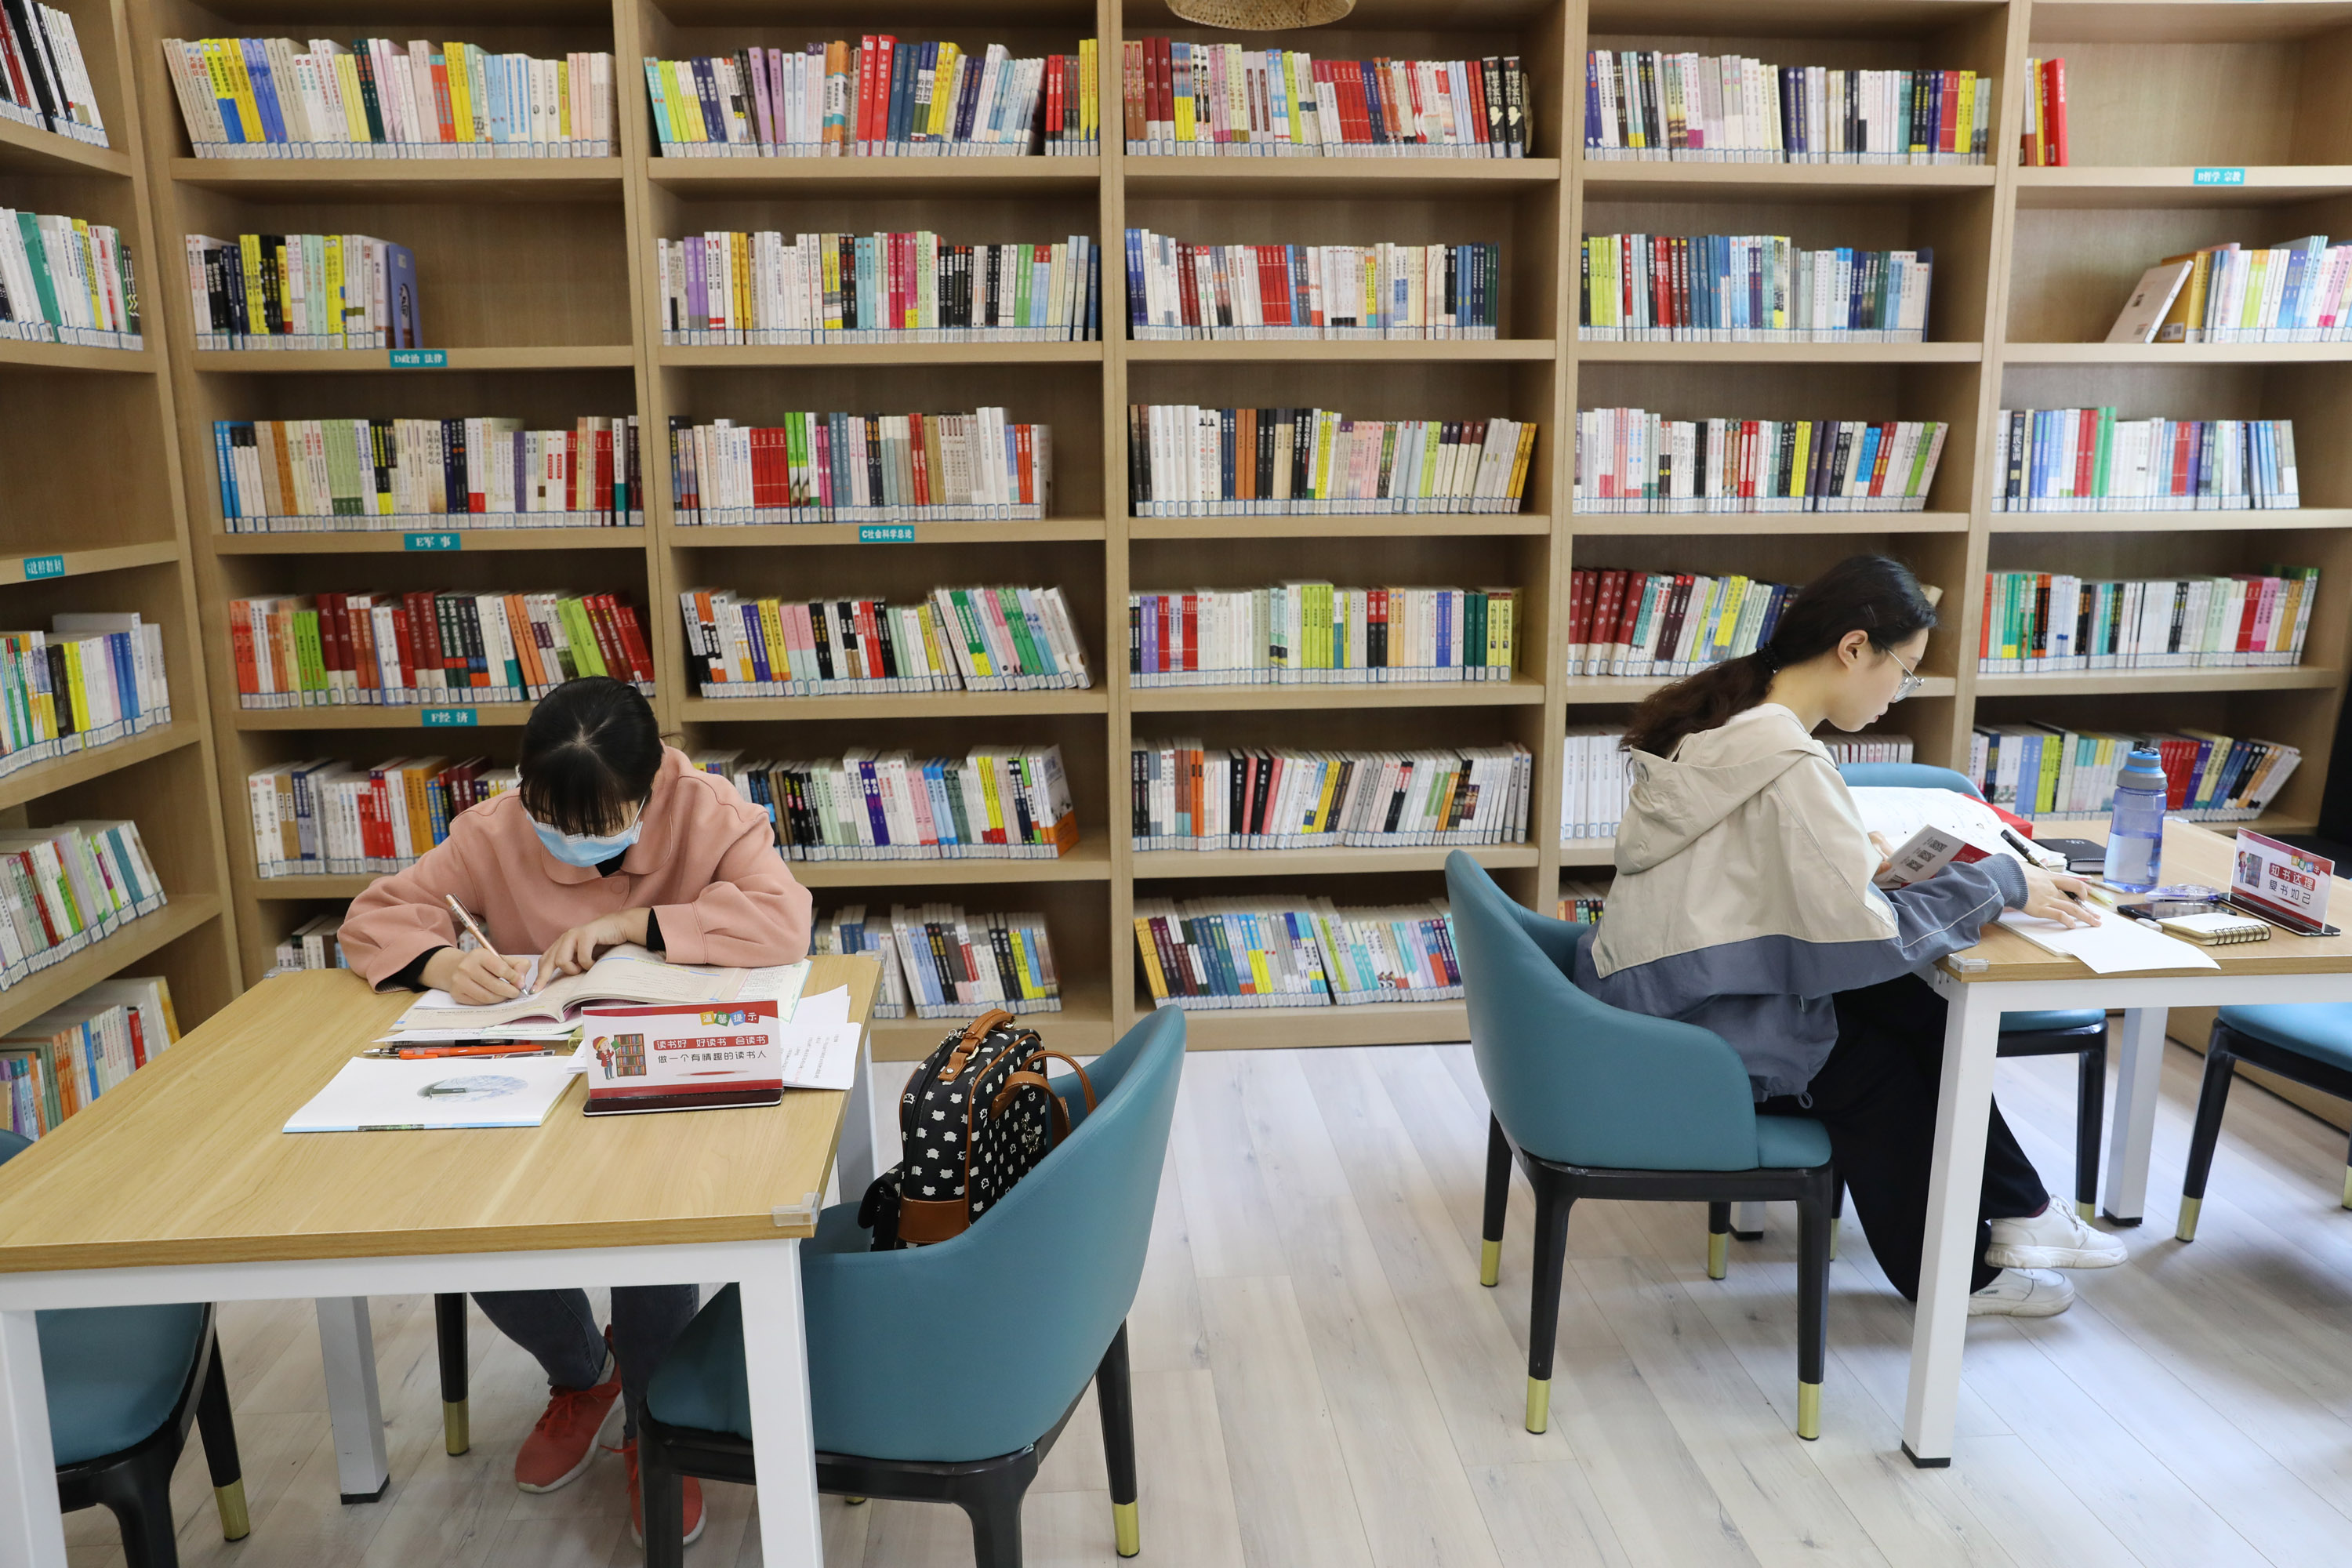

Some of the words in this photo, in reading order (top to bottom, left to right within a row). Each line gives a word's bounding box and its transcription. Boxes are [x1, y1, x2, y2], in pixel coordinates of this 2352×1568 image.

[2198, 171, 2220, 182] B哲学
[2224, 171, 2241, 182] 宗教
[394, 354, 419, 364] D政治
[424, 354, 443, 364] 法律
[862, 529, 913, 539] C社会科学总论
[416, 536, 434, 548] E军
[440, 535, 452, 548] 事
[431, 712, 451, 723] F经
[456, 711, 468, 723] 济
[2270, 866, 2314, 891] 知书达理
[2269, 880, 2311, 905] 爱书如己
[702, 1011, 758, 1025] 温馨提示
[657, 1038, 688, 1049] 读书好
[696, 1037, 727, 1047] 好读书
[658, 1051, 767, 1064] 做一个有情趣的读书人
